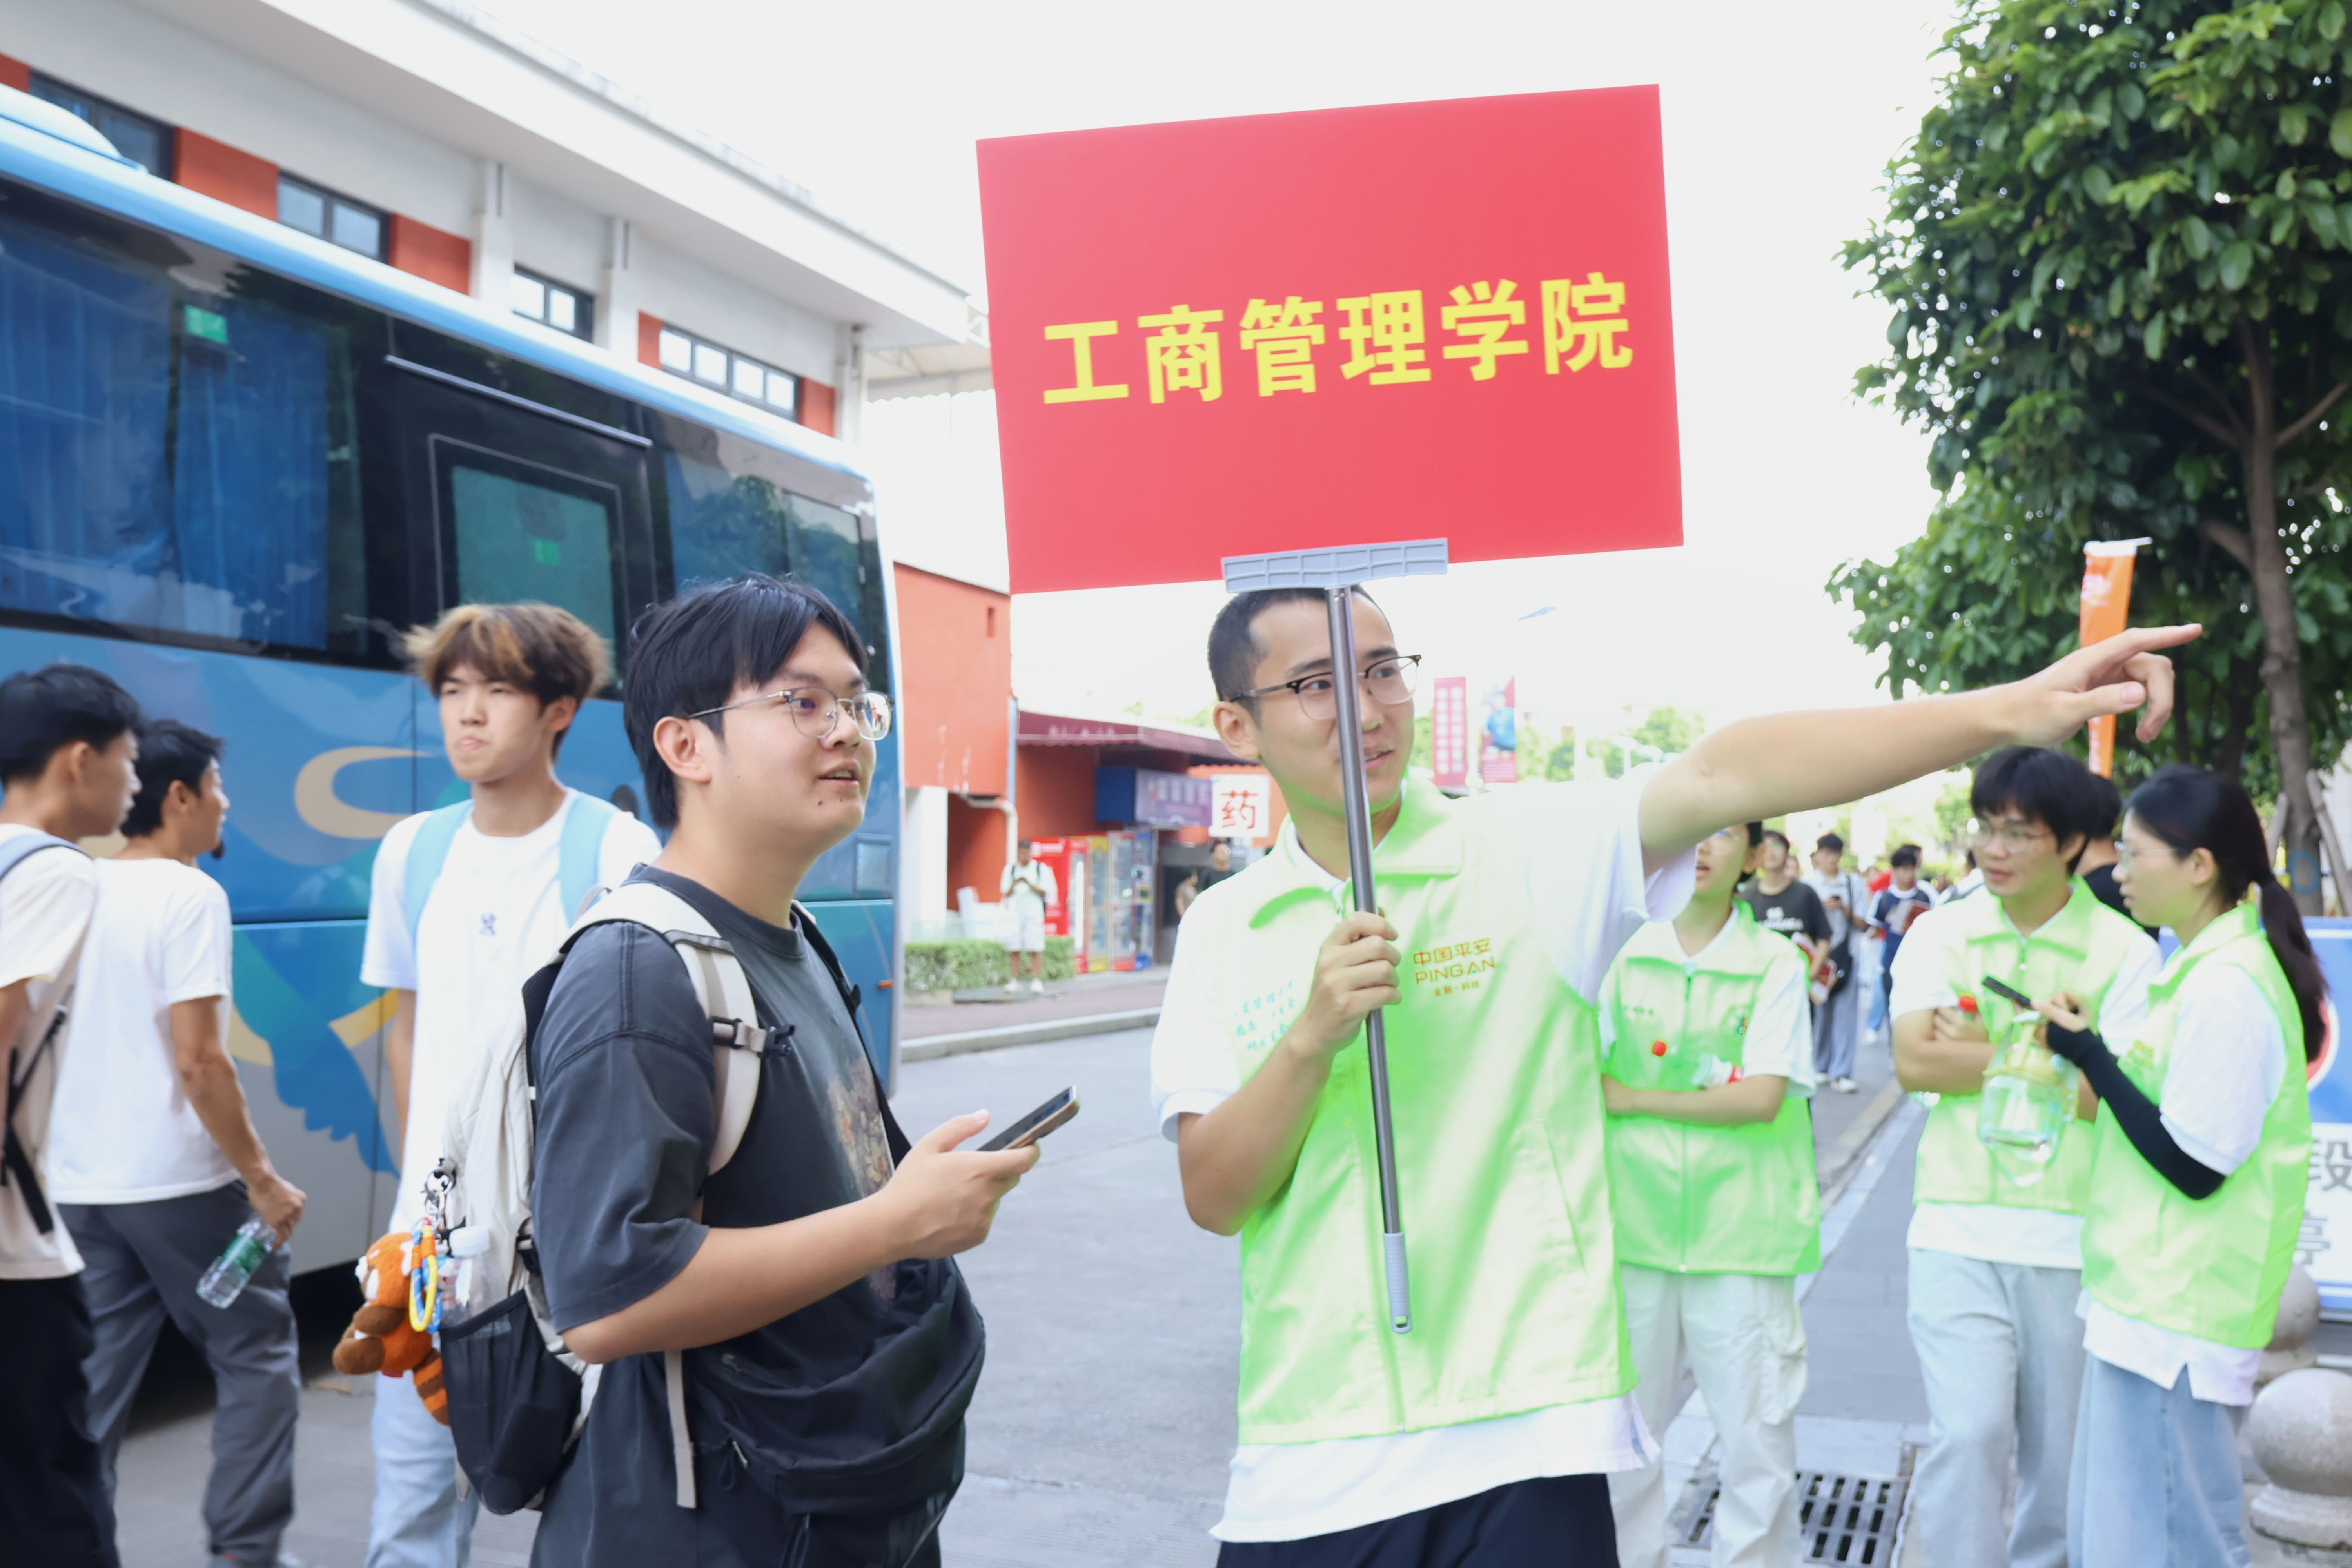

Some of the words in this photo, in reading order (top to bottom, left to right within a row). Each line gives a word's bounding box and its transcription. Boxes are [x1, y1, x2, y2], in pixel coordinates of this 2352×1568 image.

[1044, 271, 1633, 404] 工商管理学院
[1220, 789, 1258, 830] 药
[1413, 938, 1491, 965] 中国平安
